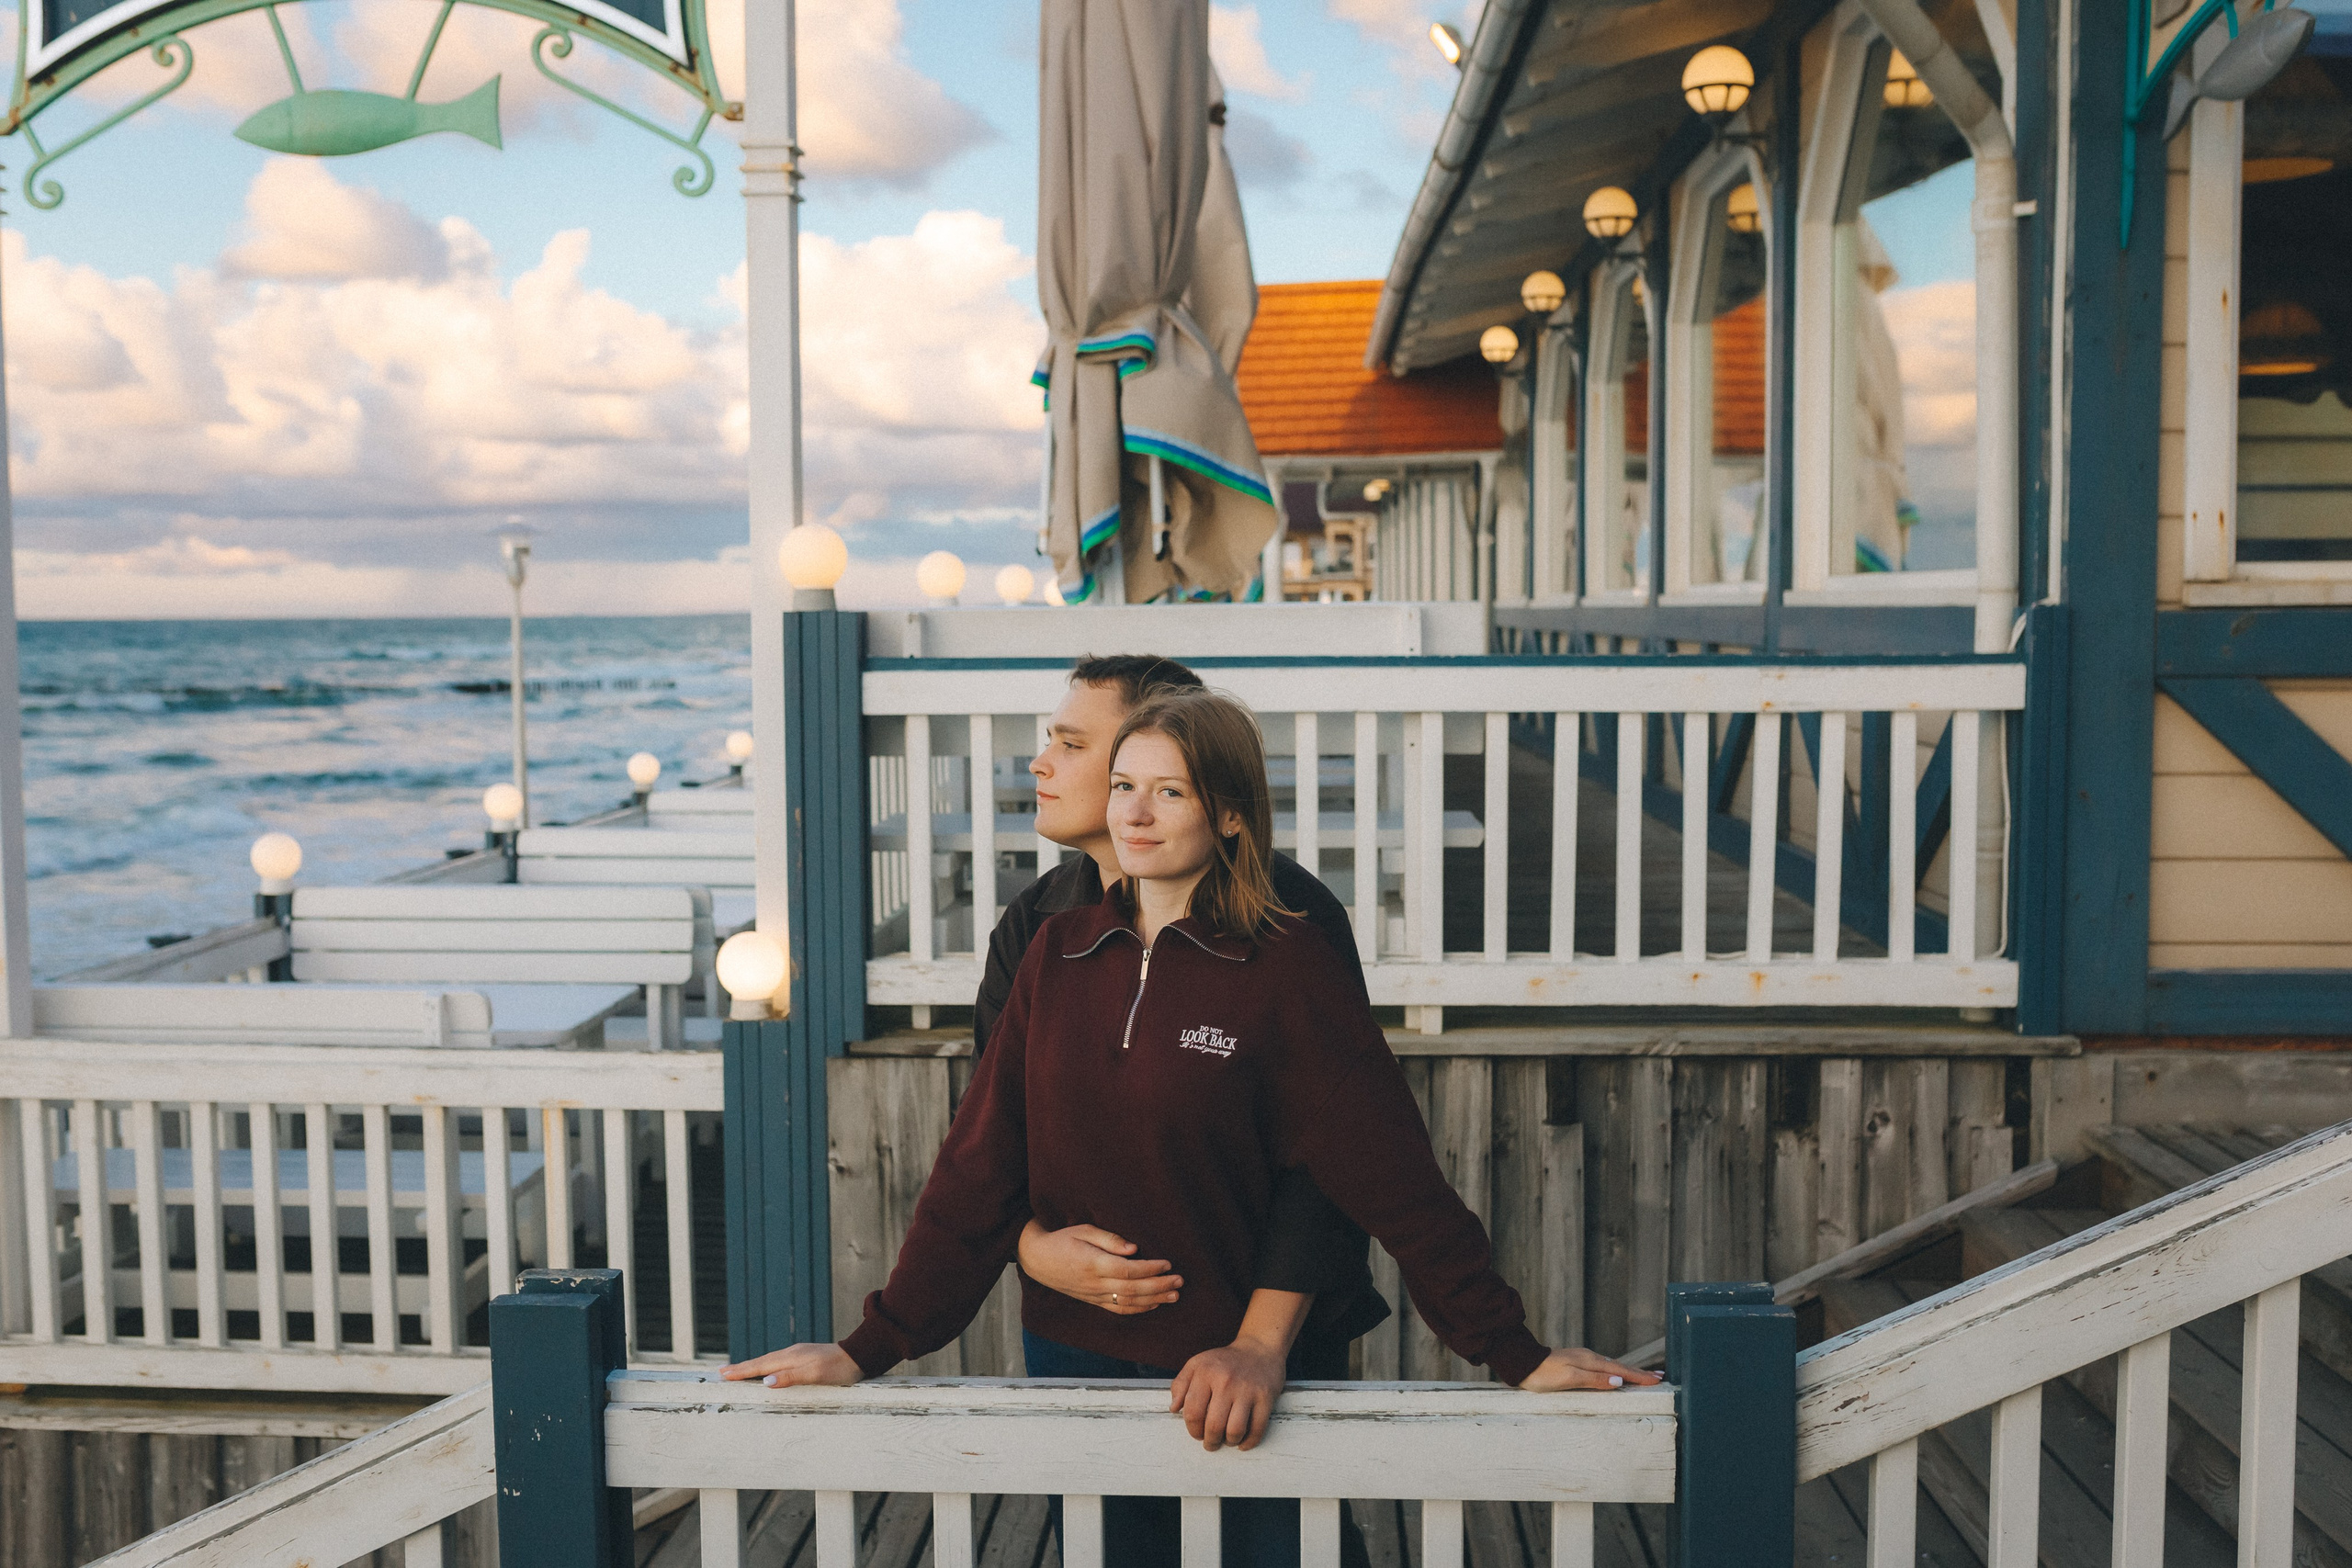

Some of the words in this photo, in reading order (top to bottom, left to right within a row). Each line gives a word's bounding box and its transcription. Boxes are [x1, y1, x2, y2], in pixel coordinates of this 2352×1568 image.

[1210, 1027, 1223, 1035] NOT
[1180, 1029, 1209, 1044] LOOK
[1209, 1033, 1238, 1050] BACK
